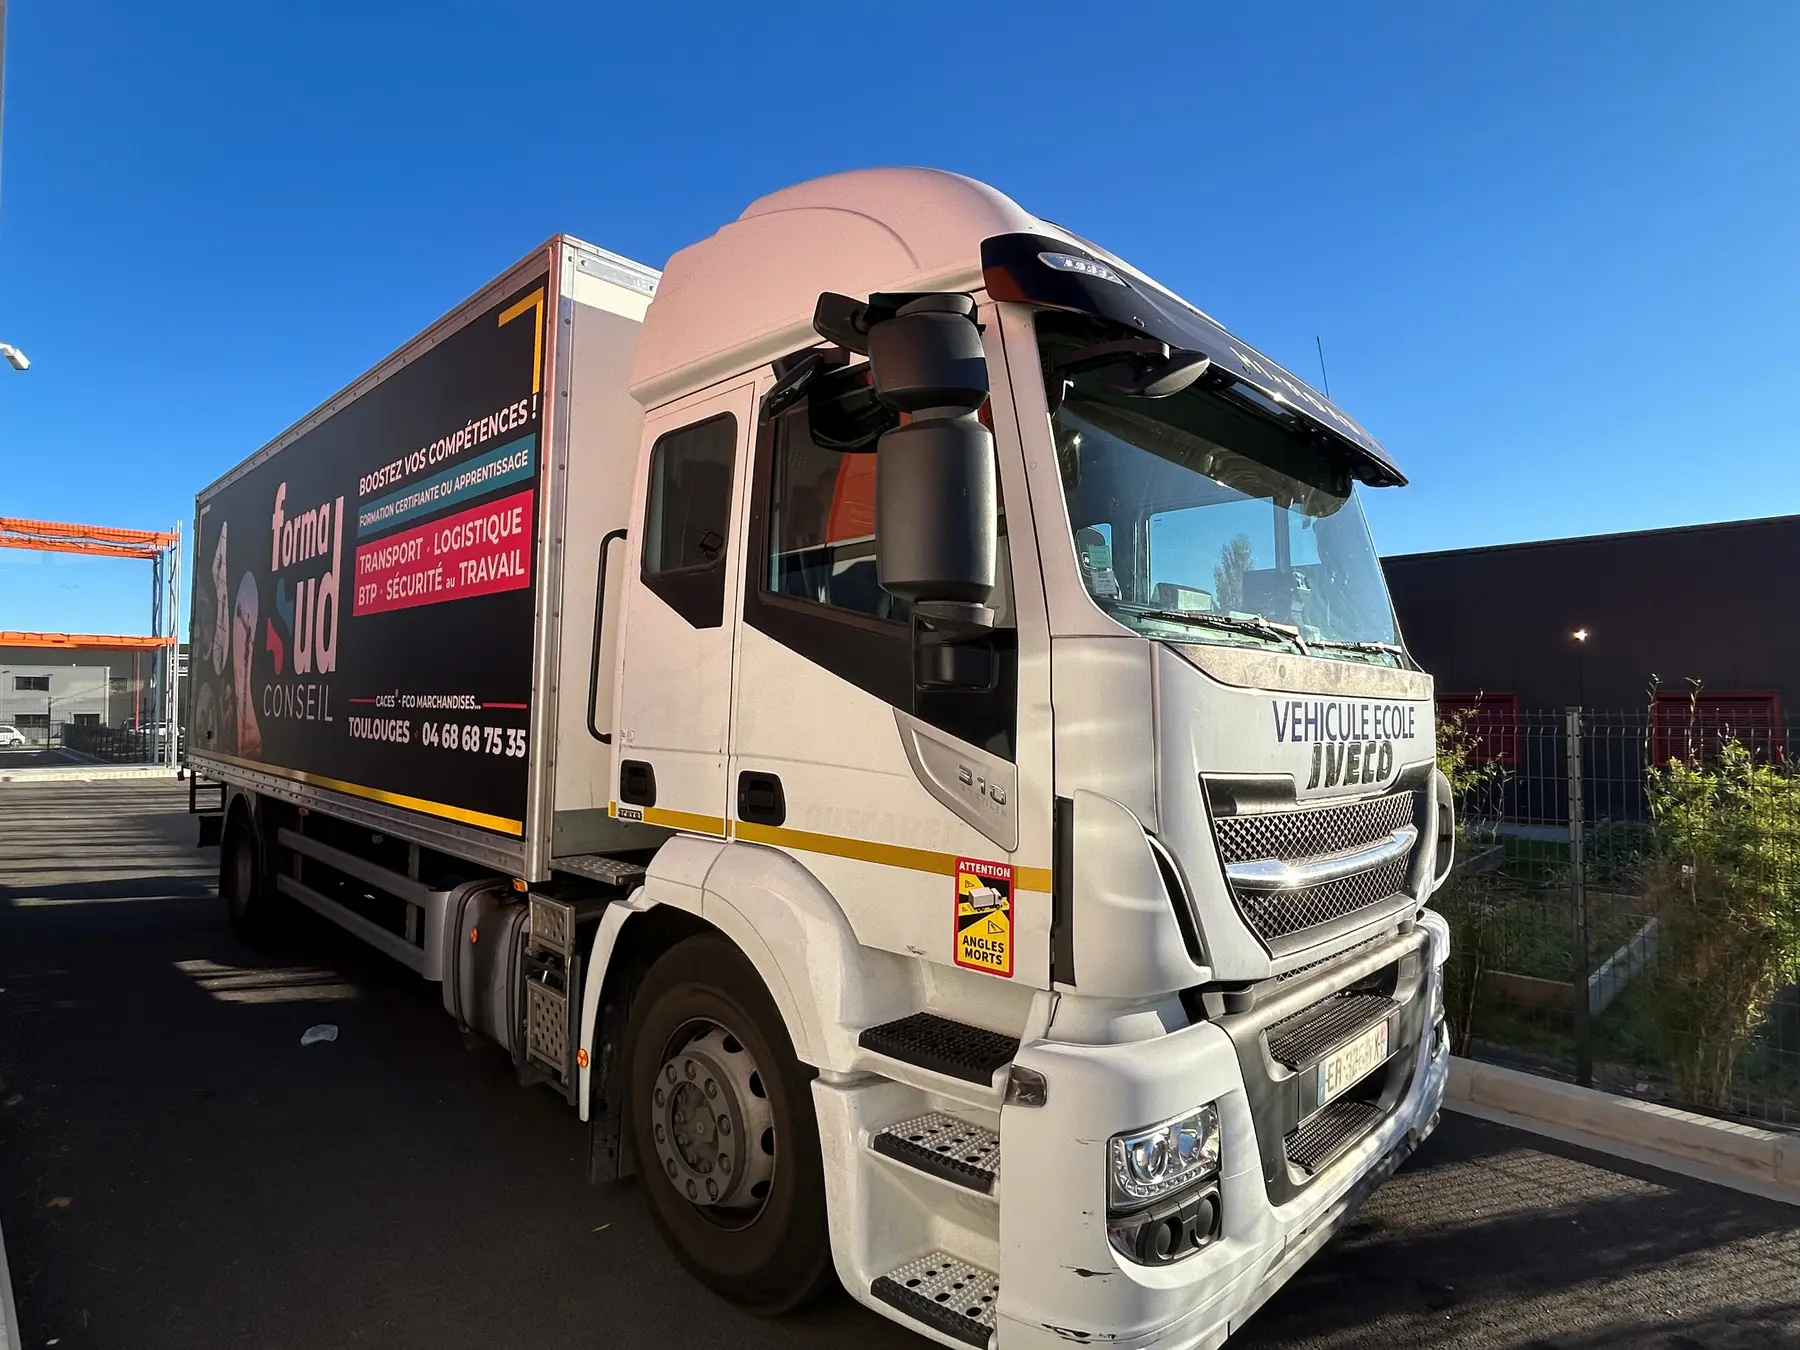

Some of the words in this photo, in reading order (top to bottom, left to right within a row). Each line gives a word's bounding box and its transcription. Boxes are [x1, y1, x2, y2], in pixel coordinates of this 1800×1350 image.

[359, 459, 402, 496] BOOSTEZ
[405, 448, 426, 475] VOS
[429, 399, 528, 464] COMPÉTENCES
[359, 505, 394, 527] FORMATION
[395, 485, 439, 513] CERTIFIANTE
[440, 479, 452, 496] OU
[453, 450, 528, 491] APPRENTISSAGE
[272, 482, 330, 571] forma
[359, 537, 423, 575] TRANSPORT
[433, 507, 523, 556] LOGISTIQUE
[358, 583, 377, 606] BTP
[386, 561, 443, 600] SÉCURITÉ
[445, 576, 456, 589] au
[459, 549, 525, 586] TRAVAIL
[263, 684, 333, 722] CONSEIL
[401, 695, 416, 709] FCO
[1272, 701, 1369, 743] VEHICULE
[1374, 704, 1415, 739] ECOLE
[348, 716, 410, 744] TOULOUGES
[422, 721, 439, 746] 04
[441, 723, 459, 749] 68
[461, 725, 480, 752] 68
[483, 727, 502, 755] 75
[505, 728, 526, 758] 35
[958, 763, 1007, 806] 310
[1306, 740, 1394, 789] IVECO
[958, 860, 1011, 878] ATTENTION
[962, 935, 1005, 953] ANGLES
[964, 947, 1003, 965] MORTS
